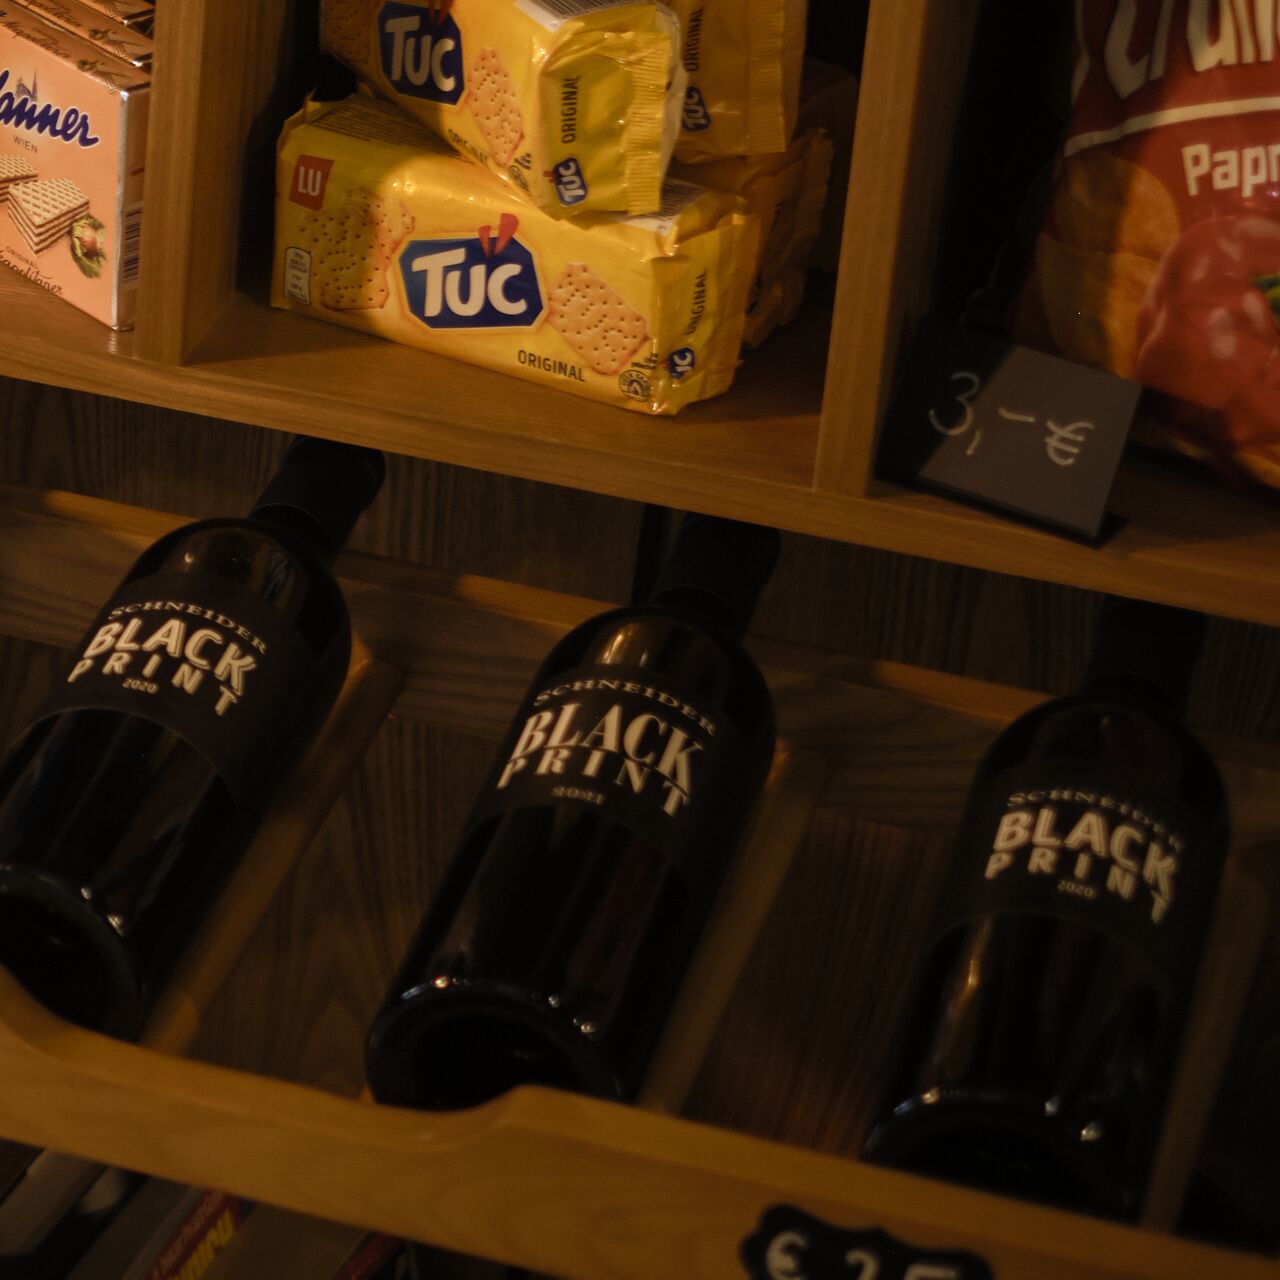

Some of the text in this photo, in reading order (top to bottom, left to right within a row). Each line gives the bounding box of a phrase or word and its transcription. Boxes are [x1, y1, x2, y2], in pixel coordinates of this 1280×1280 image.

[13, 134, 39, 153] WIEN
[560, 75, 581, 145] ORIGINAL
[296, 166, 322, 197] LU
[558, 162, 585, 202] TUC
[411, 247, 529, 318] TUC
[683, 269, 709, 336] ORIGINAL
[517, 349, 586, 383] ORIGINAL
[1045, 418, 1094, 466] €
[83, 617, 257, 697] BLACK
[108, 600, 268, 655] SCHNEIDER
[67, 650, 239, 717] PRINT
[122, 678, 160, 694] 2020
[533, 678, 716, 737] SCHNEIDER
[496, 746, 691, 818] PRINT
[508, 703, 705, 797] BLACK
[984, 846, 1171, 927] PRINT
[993, 805, 1178, 903] BLACK
